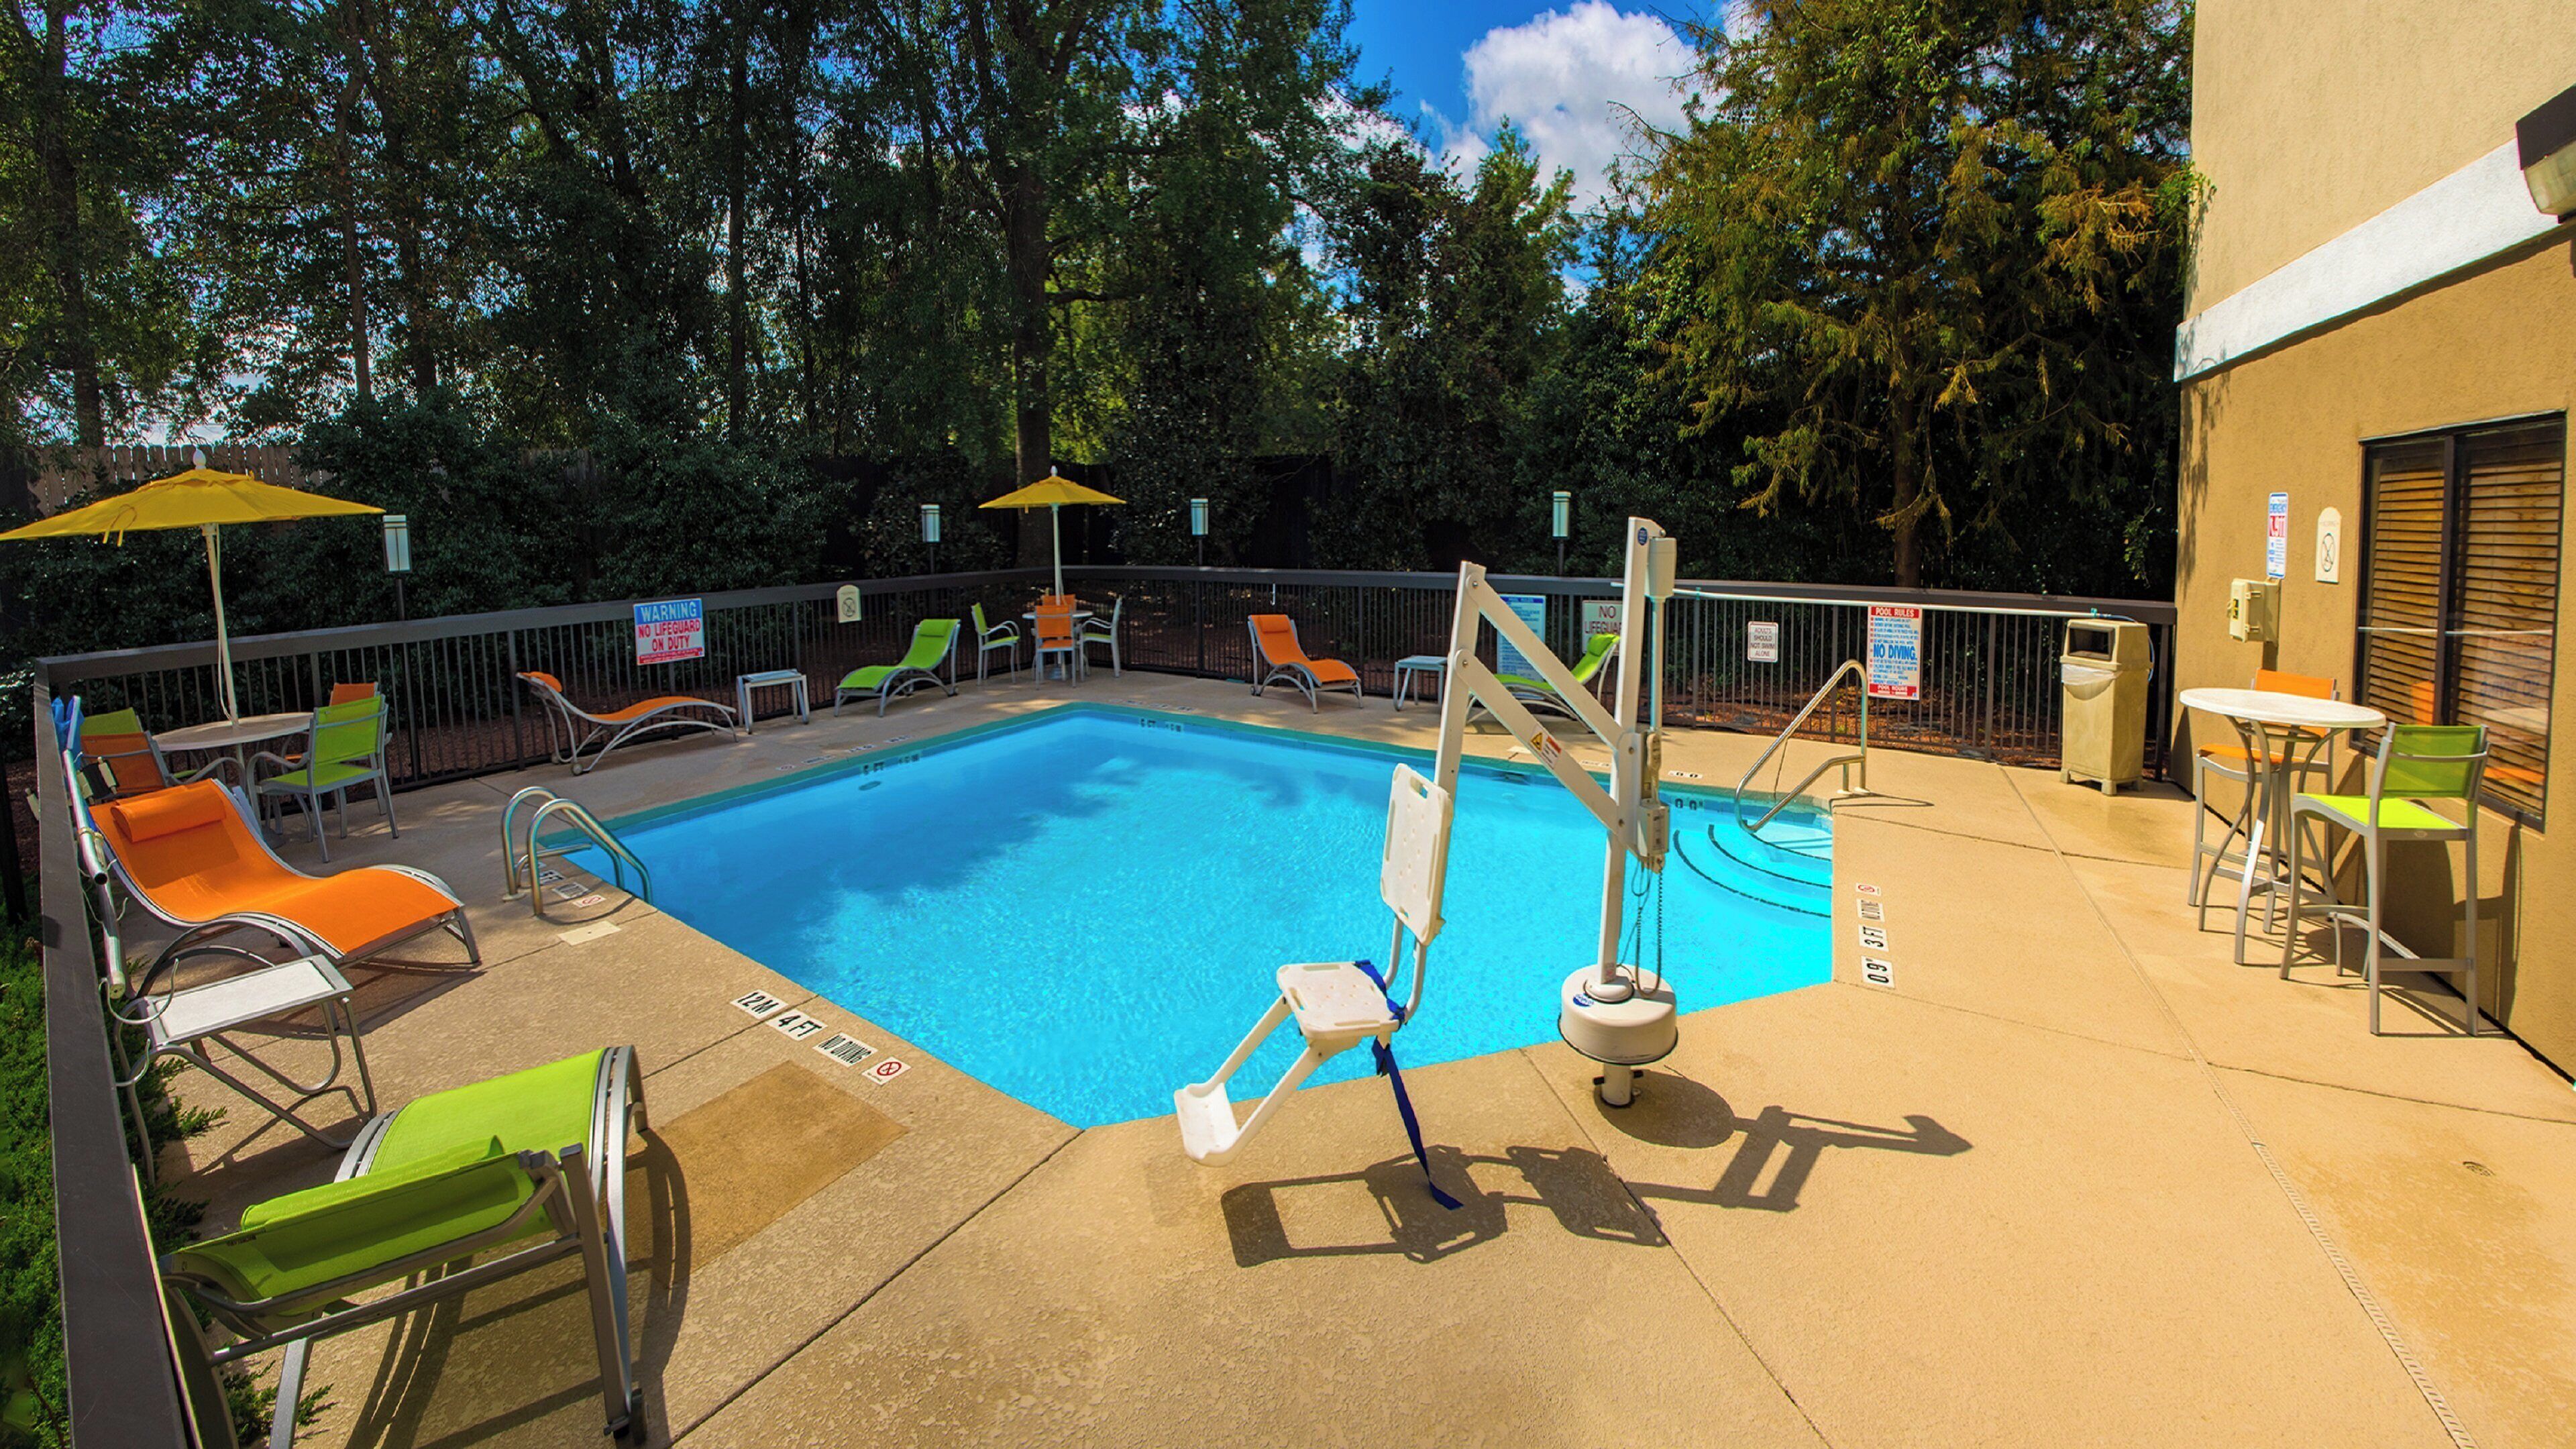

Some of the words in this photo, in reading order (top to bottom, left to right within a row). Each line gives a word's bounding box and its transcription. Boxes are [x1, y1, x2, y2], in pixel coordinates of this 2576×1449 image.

[641, 601, 697, 622] WARNING
[1599, 605, 1617, 619] NO
[1876, 606, 1892, 616] POOL
[1894, 608, 1915, 617] RULES
[638, 625, 651, 639] NO
[654, 618, 701, 637] LIFEGUARD
[652, 638, 664, 651] ON
[668, 635, 690, 650] DUTY
[1873, 643, 1886, 658] NO
[1863, 926, 1883, 938] FT
[1864, 939, 1884, 947] 3
[778, 1015, 802, 1028] 4
[788, 1020, 822, 1037] FT
